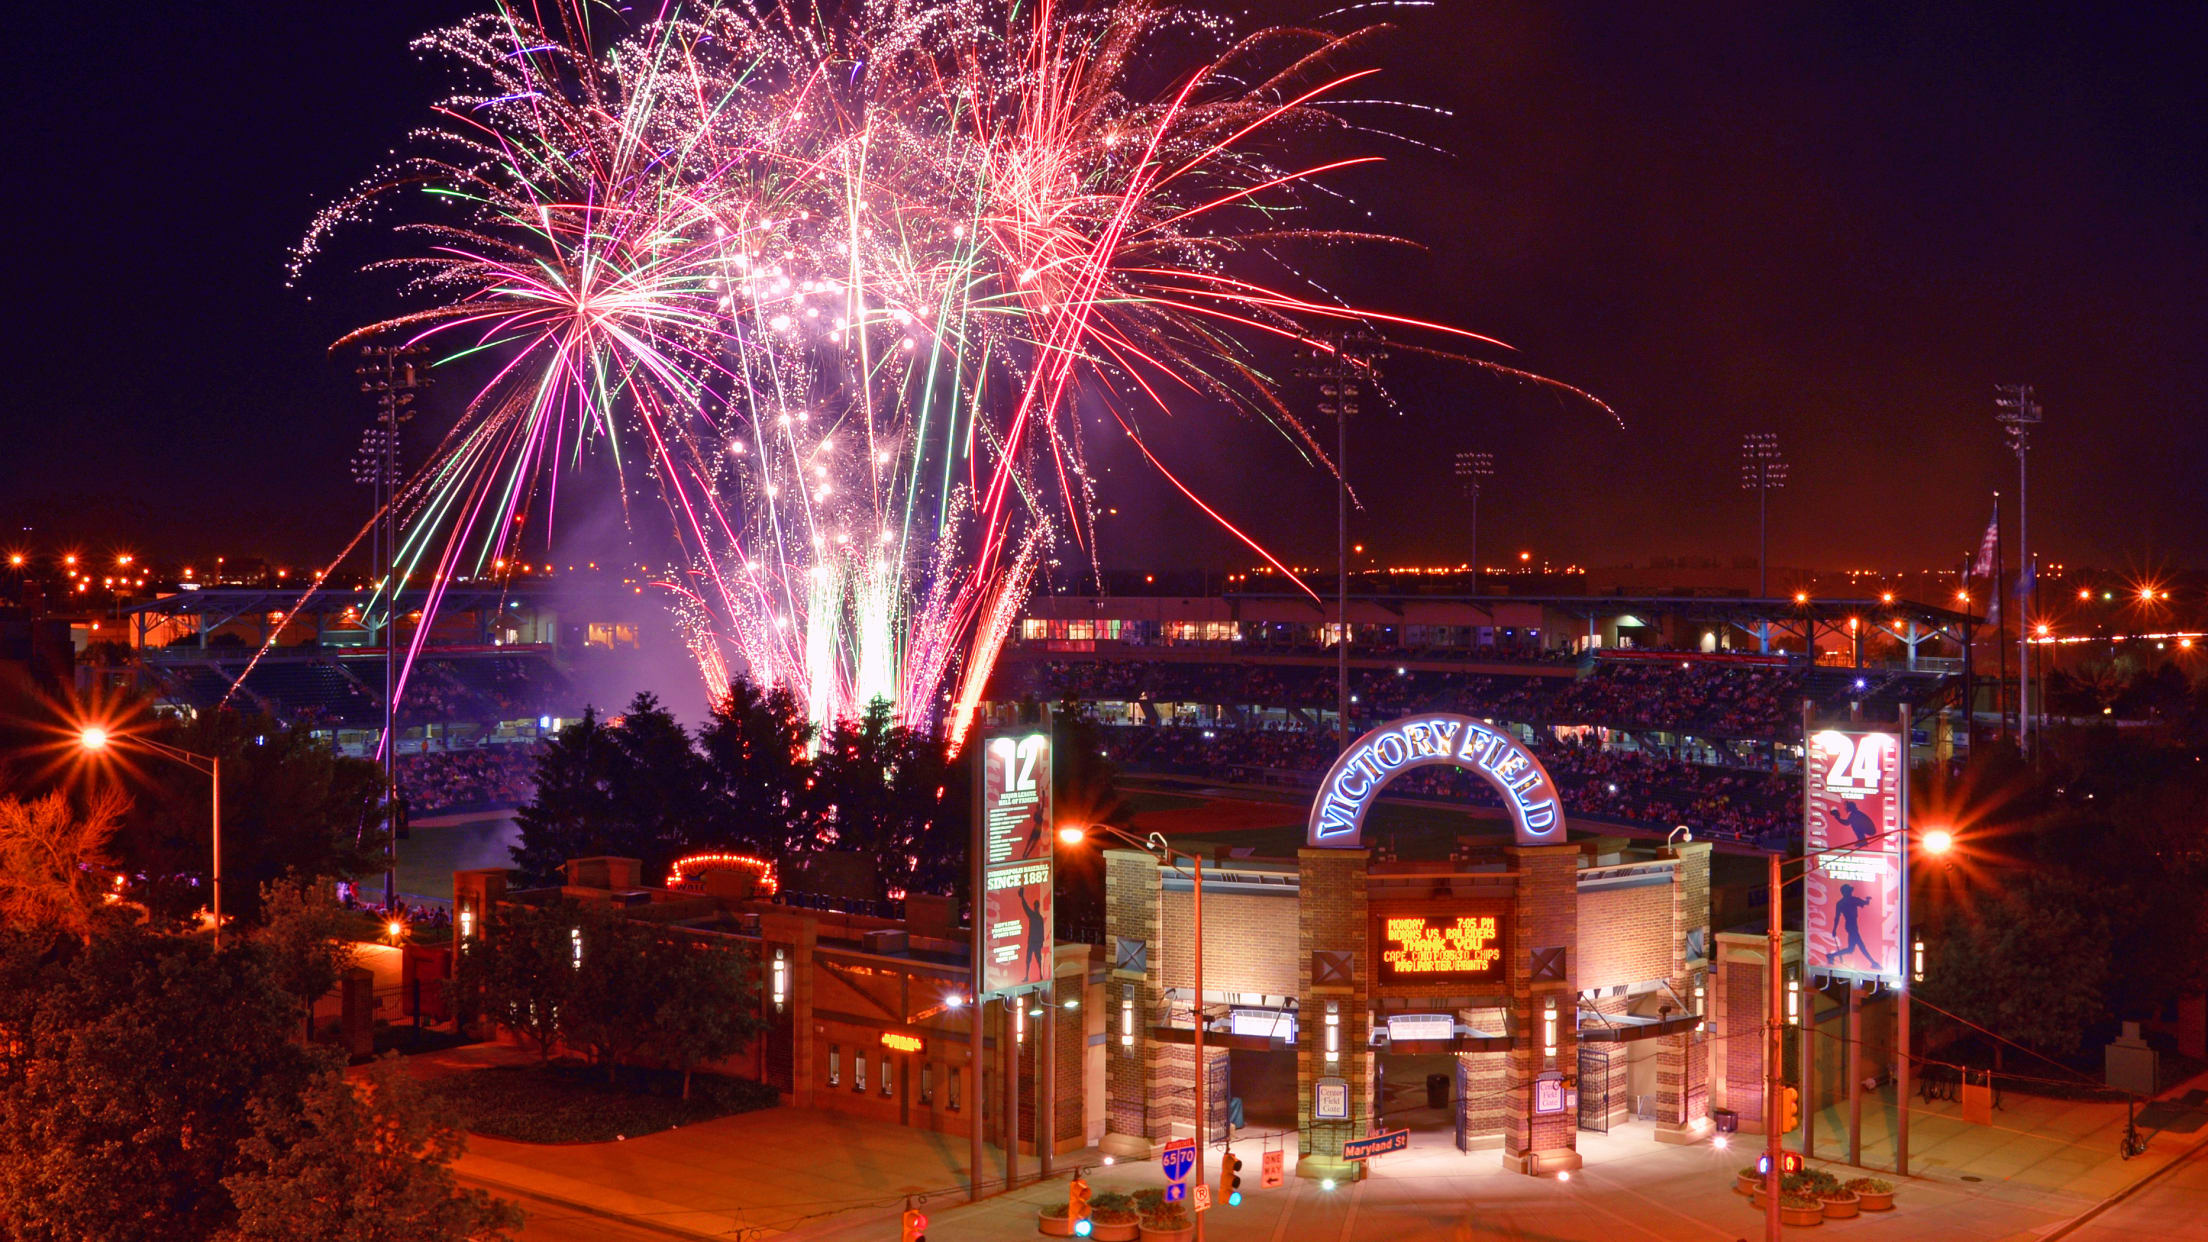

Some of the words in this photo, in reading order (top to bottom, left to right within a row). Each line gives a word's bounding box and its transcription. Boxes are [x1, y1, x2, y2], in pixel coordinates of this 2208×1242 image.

[994, 734, 1045, 792] 12
[1822, 730, 1886, 788] 24
[1317, 720, 1461, 838] VICTORY
[1459, 724, 1557, 835] FIELD
[987, 874, 1022, 890] SINCE
[1023, 870, 1049, 885] 1887
[1388, 918, 1425, 930] MONDAY
[1457, 918, 1477, 928] 7:05
[1481, 917, 1495, 929] PM
[1388, 929, 1422, 941] INDIANS
[1445, 928, 1496, 939] RAILRIDERS
[1401, 939, 1446, 951] THANK
[1453, 937, 1482, 950] YOU
[1384, 951, 1406, 962] CAPE
[1475, 949, 1500, 960] CHIPS
[1321, 1088, 1343, 1096] Center
[1323, 1096, 1340, 1105] Field
[1322, 1104, 1341, 1113] Gate
[1345, 1139, 1393, 1157] Maryland
[1394, 1135, 1406, 1147] St
[1162, 1153, 1177, 1166] 65
[1180, 1150, 1194, 1163] 70
[1265, 1154, 1281, 1164] ONE
[1264, 1166, 1281, 1175] WAY
